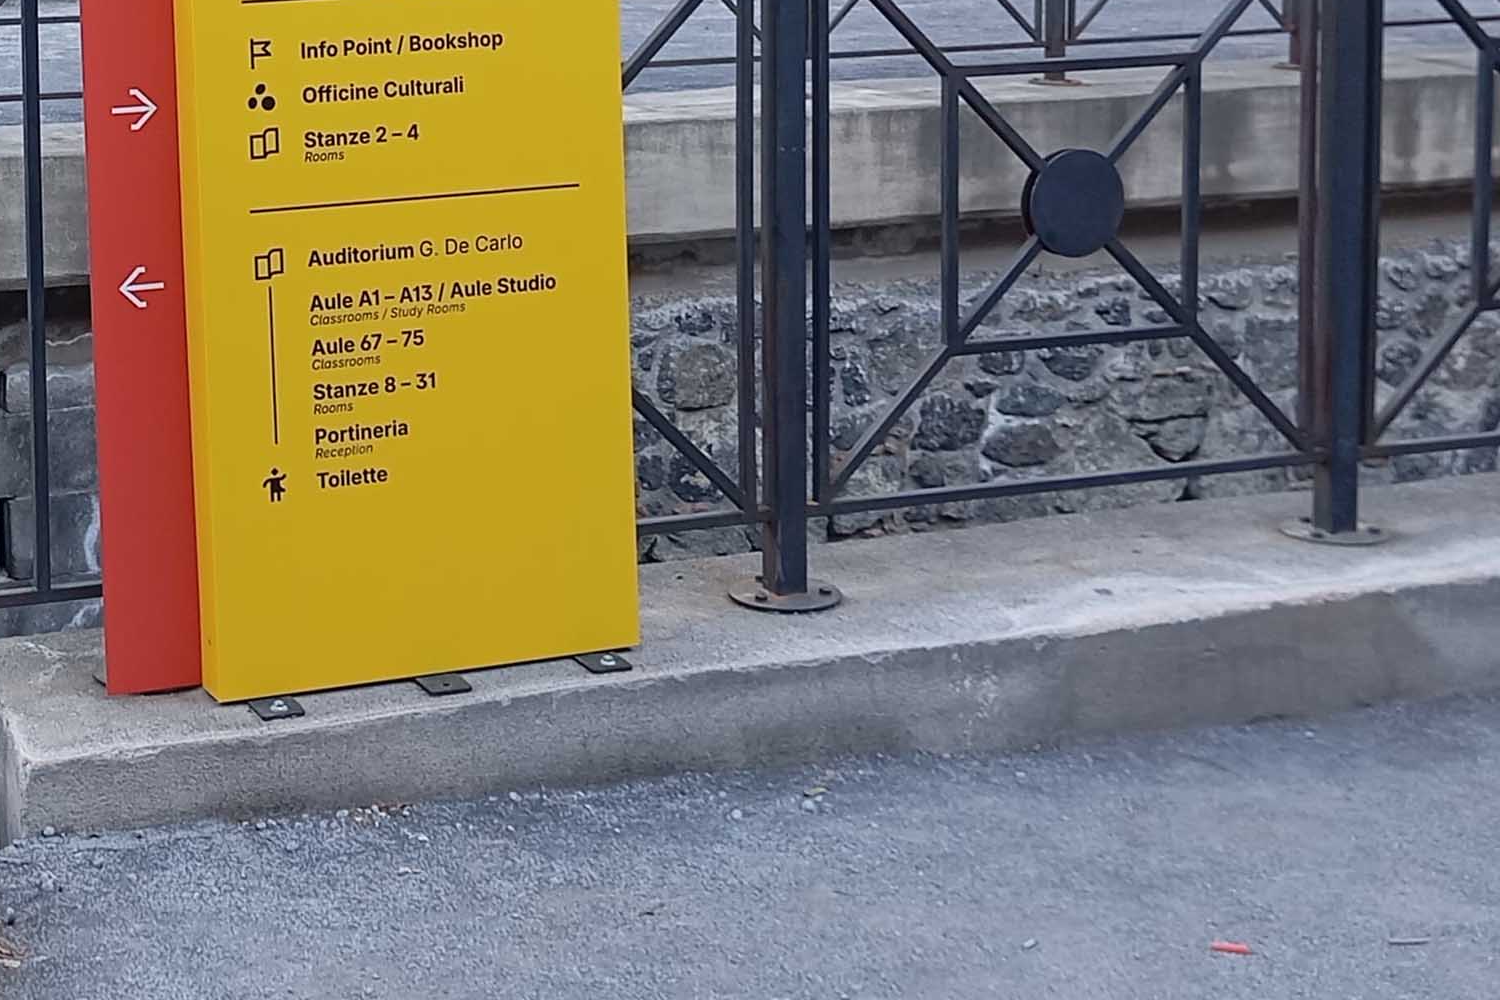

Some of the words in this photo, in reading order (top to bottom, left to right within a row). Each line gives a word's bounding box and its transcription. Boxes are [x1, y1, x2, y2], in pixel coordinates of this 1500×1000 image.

[301, 41, 338, 59] Info
[344, 37, 392, 56] Point
[397, 35, 404, 55] /
[409, 32, 503, 52] Bookshop
[302, 84, 378, 103] Officine
[384, 76, 464, 97] Culturali
[304, 129, 370, 148] Stanze
[376, 127, 387, 143] 2
[407, 124, 419, 140] 4
[304, 151, 345, 163] Rooms
[308, 244, 414, 267] Auditorium
[419, 241, 439, 257] G.
[445, 238, 469, 255] De
[475, 233, 522, 251] Carlo
[310, 294, 353, 312] Aule
[359, 290, 379, 306] A1
[400, 285, 433, 303] A13
[438, 283, 445, 302] /
[451, 280, 492, 299] Aule
[497, 274, 556, 294] Studio
[310, 310, 379, 326] Classrooms
[390, 306, 423, 320] Study
[427, 302, 466, 315] Rooms
[312, 337, 354, 356] Aule
[360, 334, 381, 351] 67
[402, 330, 424, 346] 75
[312, 354, 380, 371] Classrooms
[313, 380, 379, 401] Stanze
[384, 377, 396, 393] 8
[416, 372, 436, 389] 31
[313, 401, 353, 415] Rooms
[315, 420, 408, 445] Portineria
[315, 444, 373, 460] Reception
[317, 467, 388, 489] Toilette
